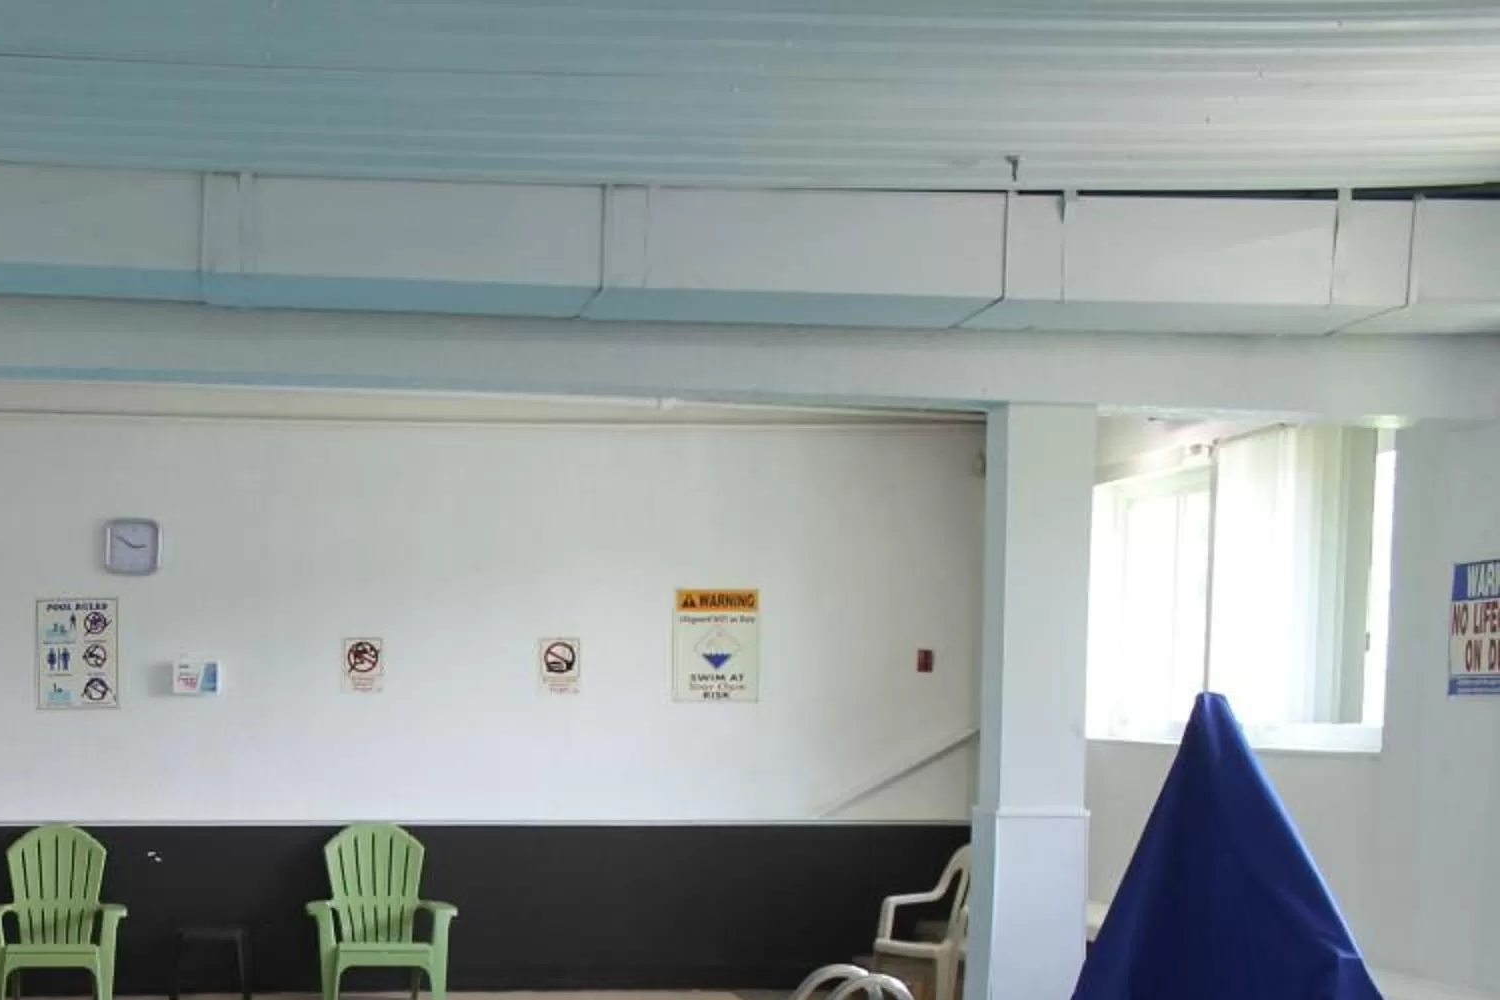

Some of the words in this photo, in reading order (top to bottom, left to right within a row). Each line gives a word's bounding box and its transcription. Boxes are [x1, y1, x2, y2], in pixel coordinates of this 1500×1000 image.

[46, 602, 71, 611] POOL
[699, 593, 755, 608] WARNING
[1452, 602, 1469, 637] NO
[1465, 639, 1482, 673] ON
[690, 674, 725, 682] SWIM
[730, 674, 744, 682] AT
[703, 691, 729, 699] RISK
